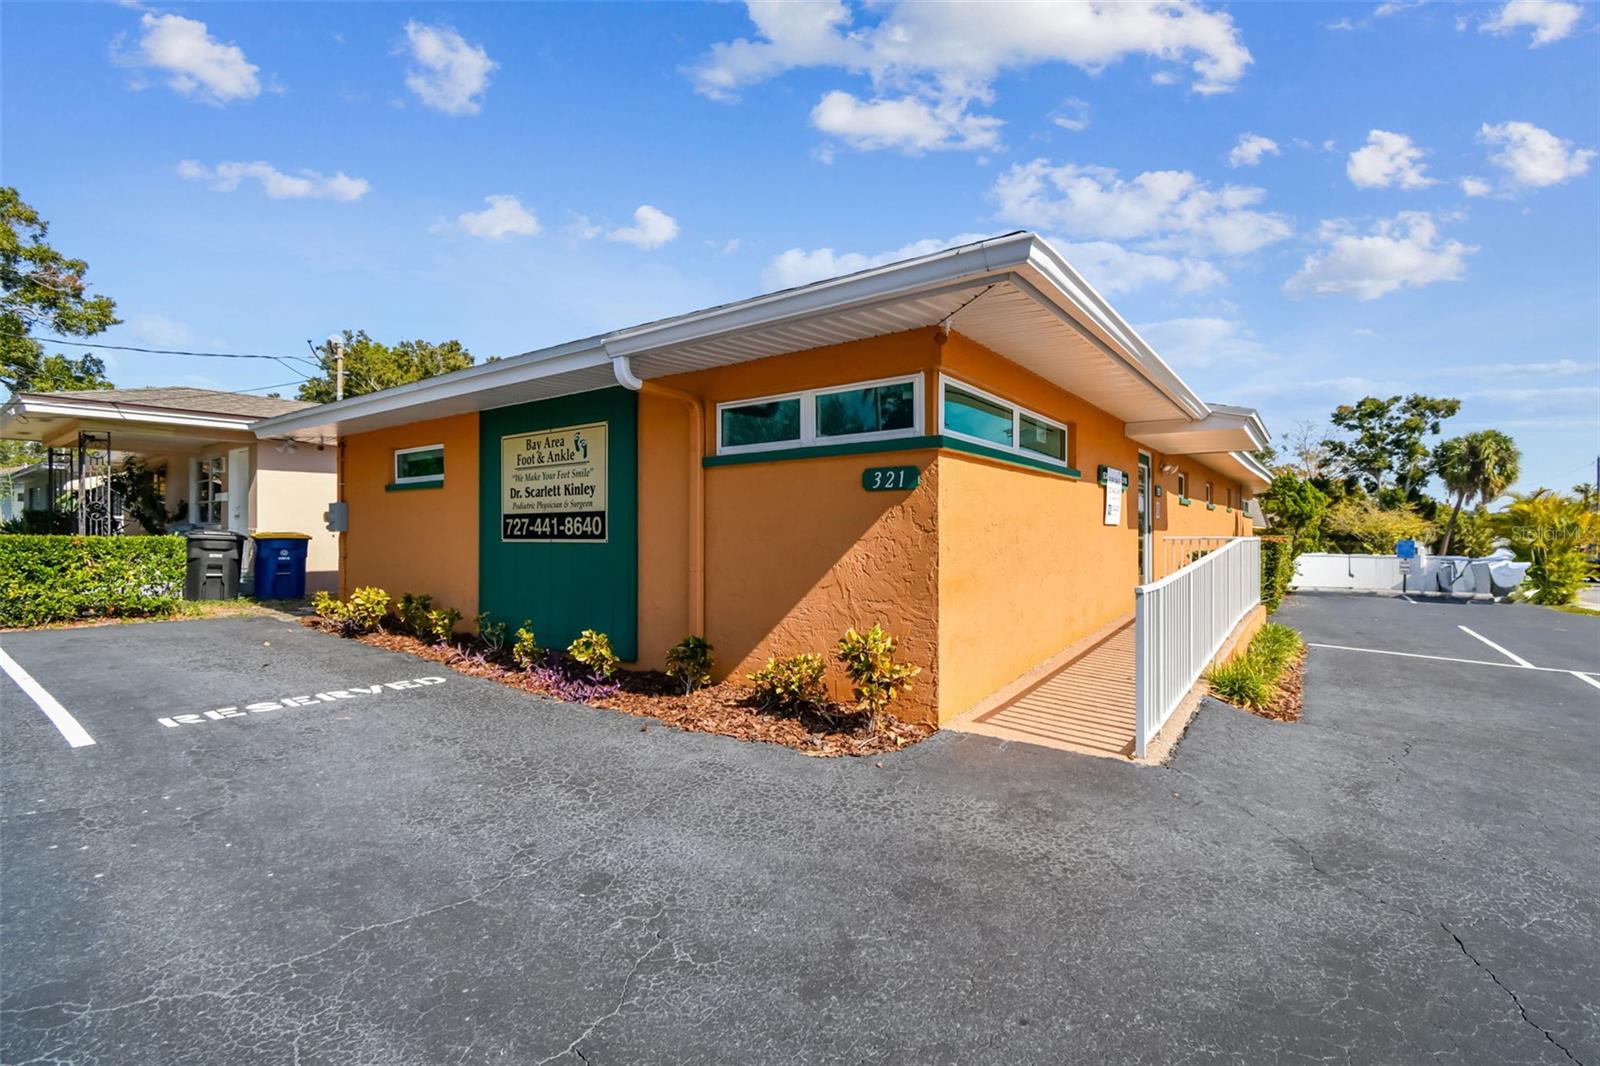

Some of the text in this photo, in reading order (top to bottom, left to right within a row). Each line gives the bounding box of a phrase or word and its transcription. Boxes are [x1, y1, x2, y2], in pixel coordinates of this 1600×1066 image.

[526, 437, 565, 451] Bay Area
[517, 448, 575, 466] Foot & Ankle
[525, 472, 541, 481] Make
[542, 471, 556, 480] Your
[557, 470, 570, 479] Feet
[872, 470, 904, 488] 321
[510, 482, 596, 499] Dr. Scarlett Kinley
[536, 501, 562, 510] Physician
[570, 500, 593, 509] Surgeon
[505, 516, 602, 536] 727-441-8640
[157, 676, 447, 728] RESERVED
